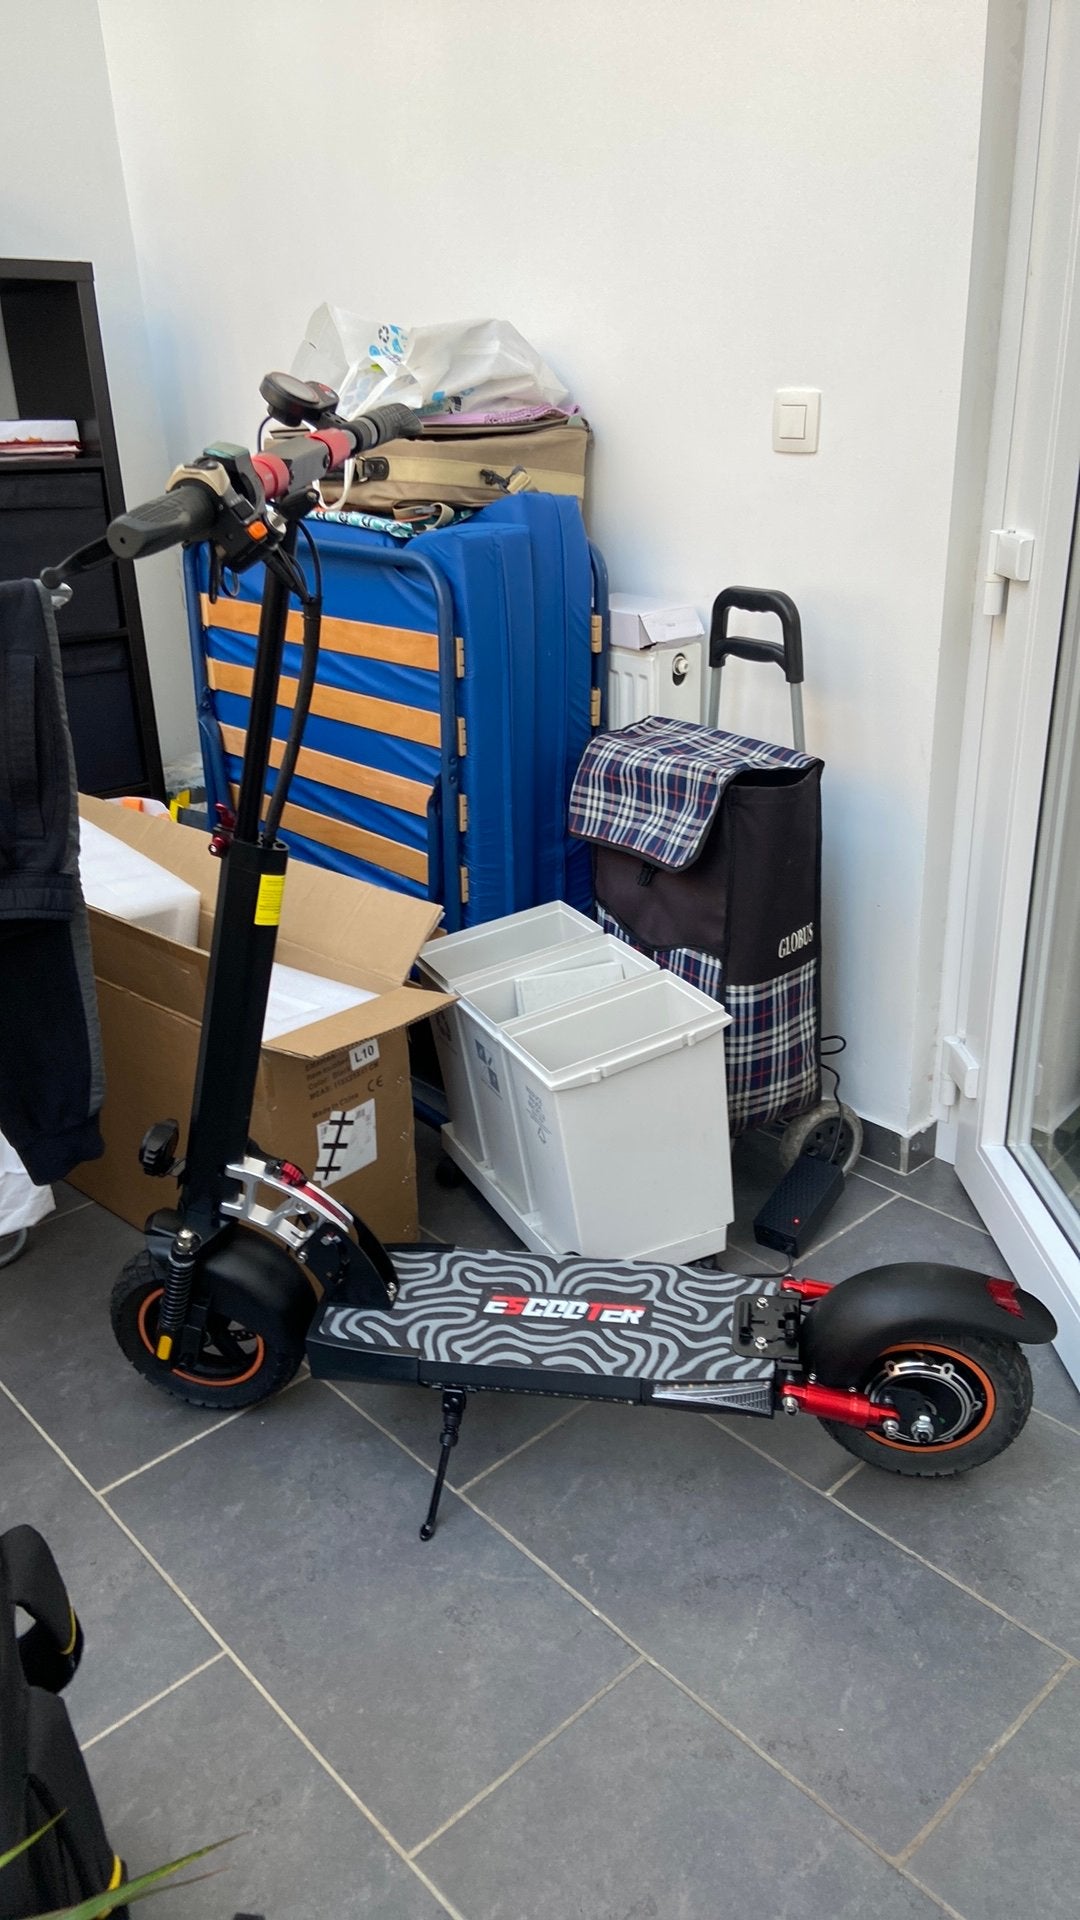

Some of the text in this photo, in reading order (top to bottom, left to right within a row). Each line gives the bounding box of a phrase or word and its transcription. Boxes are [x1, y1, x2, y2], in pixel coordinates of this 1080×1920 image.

[778, 922, 813, 958] GLOBUS
[354, 1045, 374, 1063] L10
[483, 1295, 646, 1325] ESCOOTER
